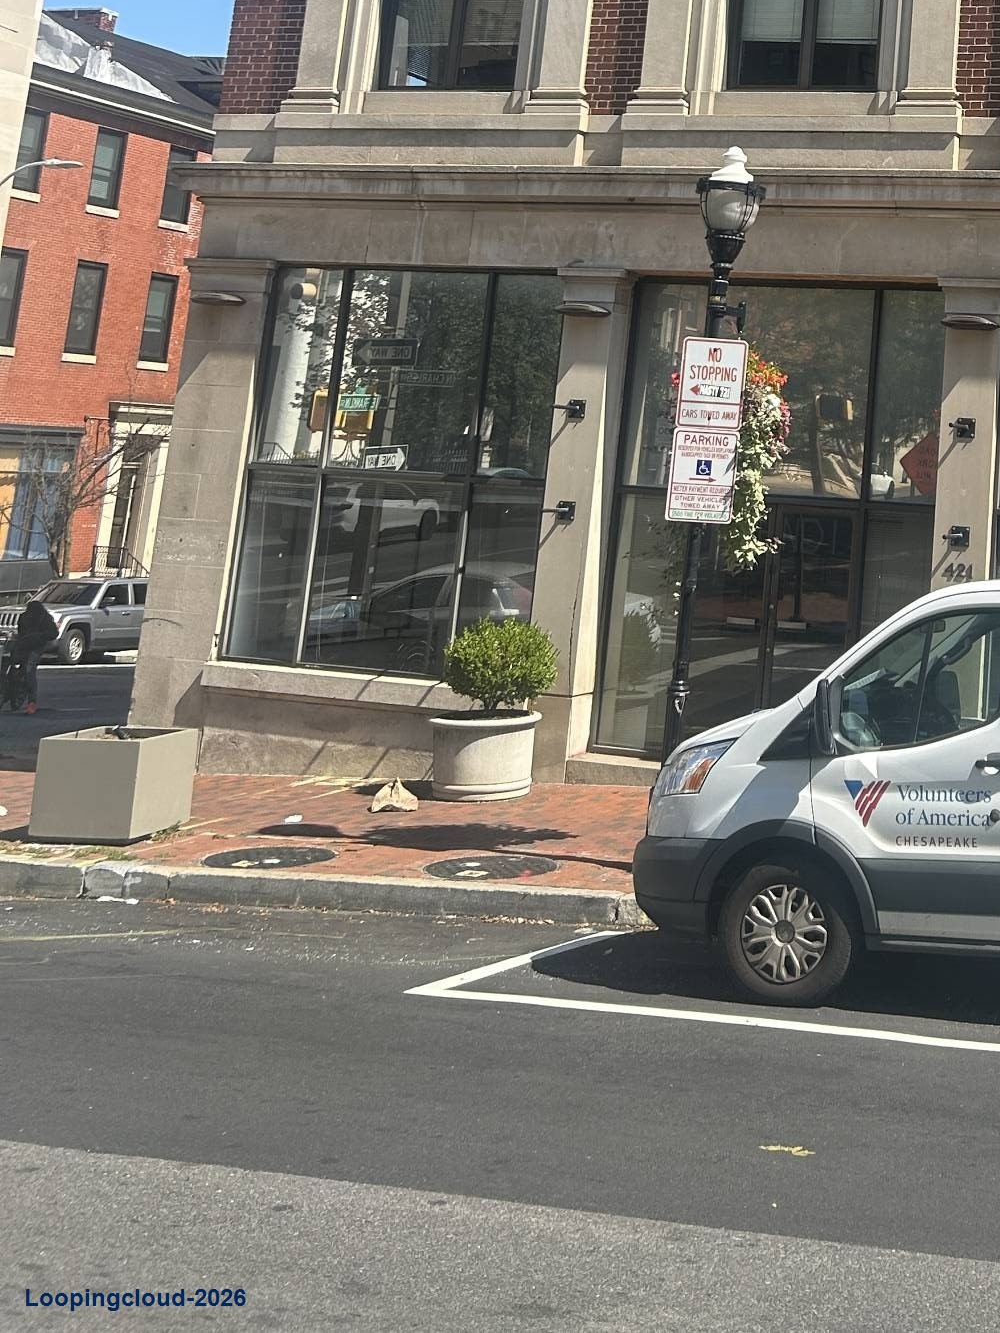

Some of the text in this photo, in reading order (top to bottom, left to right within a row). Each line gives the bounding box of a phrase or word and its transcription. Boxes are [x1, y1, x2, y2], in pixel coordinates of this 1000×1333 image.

[708, 347, 722, 363] NO
[689, 365, 738, 382] STOPPING
[681, 409, 738, 421] CARS TOWED AWAY
[683, 434, 729, 447] PARKING
[942, 562, 974, 581] 421
[897, 785, 992, 803] Volunteers
[895, 808, 992, 827] of America
[895, 835, 978, 848] CHESAPEAKE
